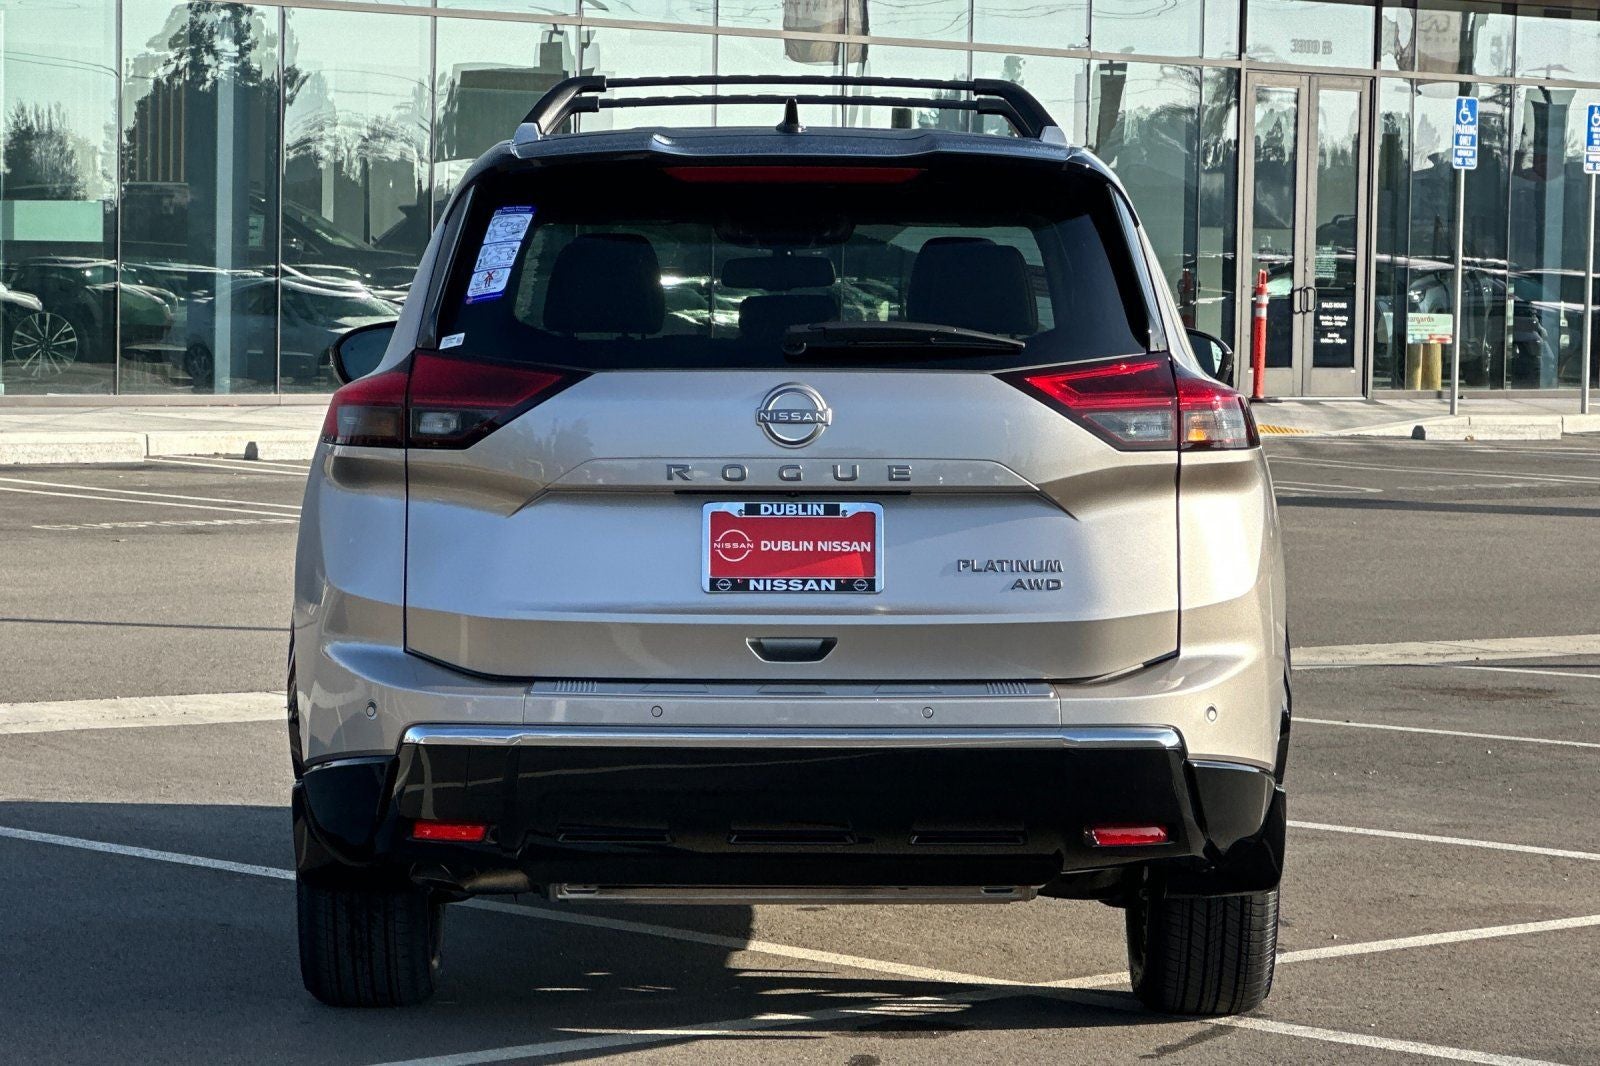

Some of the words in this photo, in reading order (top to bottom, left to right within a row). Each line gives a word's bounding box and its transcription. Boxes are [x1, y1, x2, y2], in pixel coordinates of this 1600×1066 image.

[1456, 124, 1476, 135] PARKING
[1459, 136, 1472, 146] ONLY
[760, 412, 826, 422] NISSAN
[666, 463, 913, 482] ROGUE
[760, 503, 825, 516] DUBLIN
[760, 540, 813, 552] DUBLIN
[817, 541, 871, 553] NISSAN
[957, 559, 1063, 573] PLATINUM
[750, 579, 836, 591] NISSAN
[1010, 578, 1063, 591] AWD
